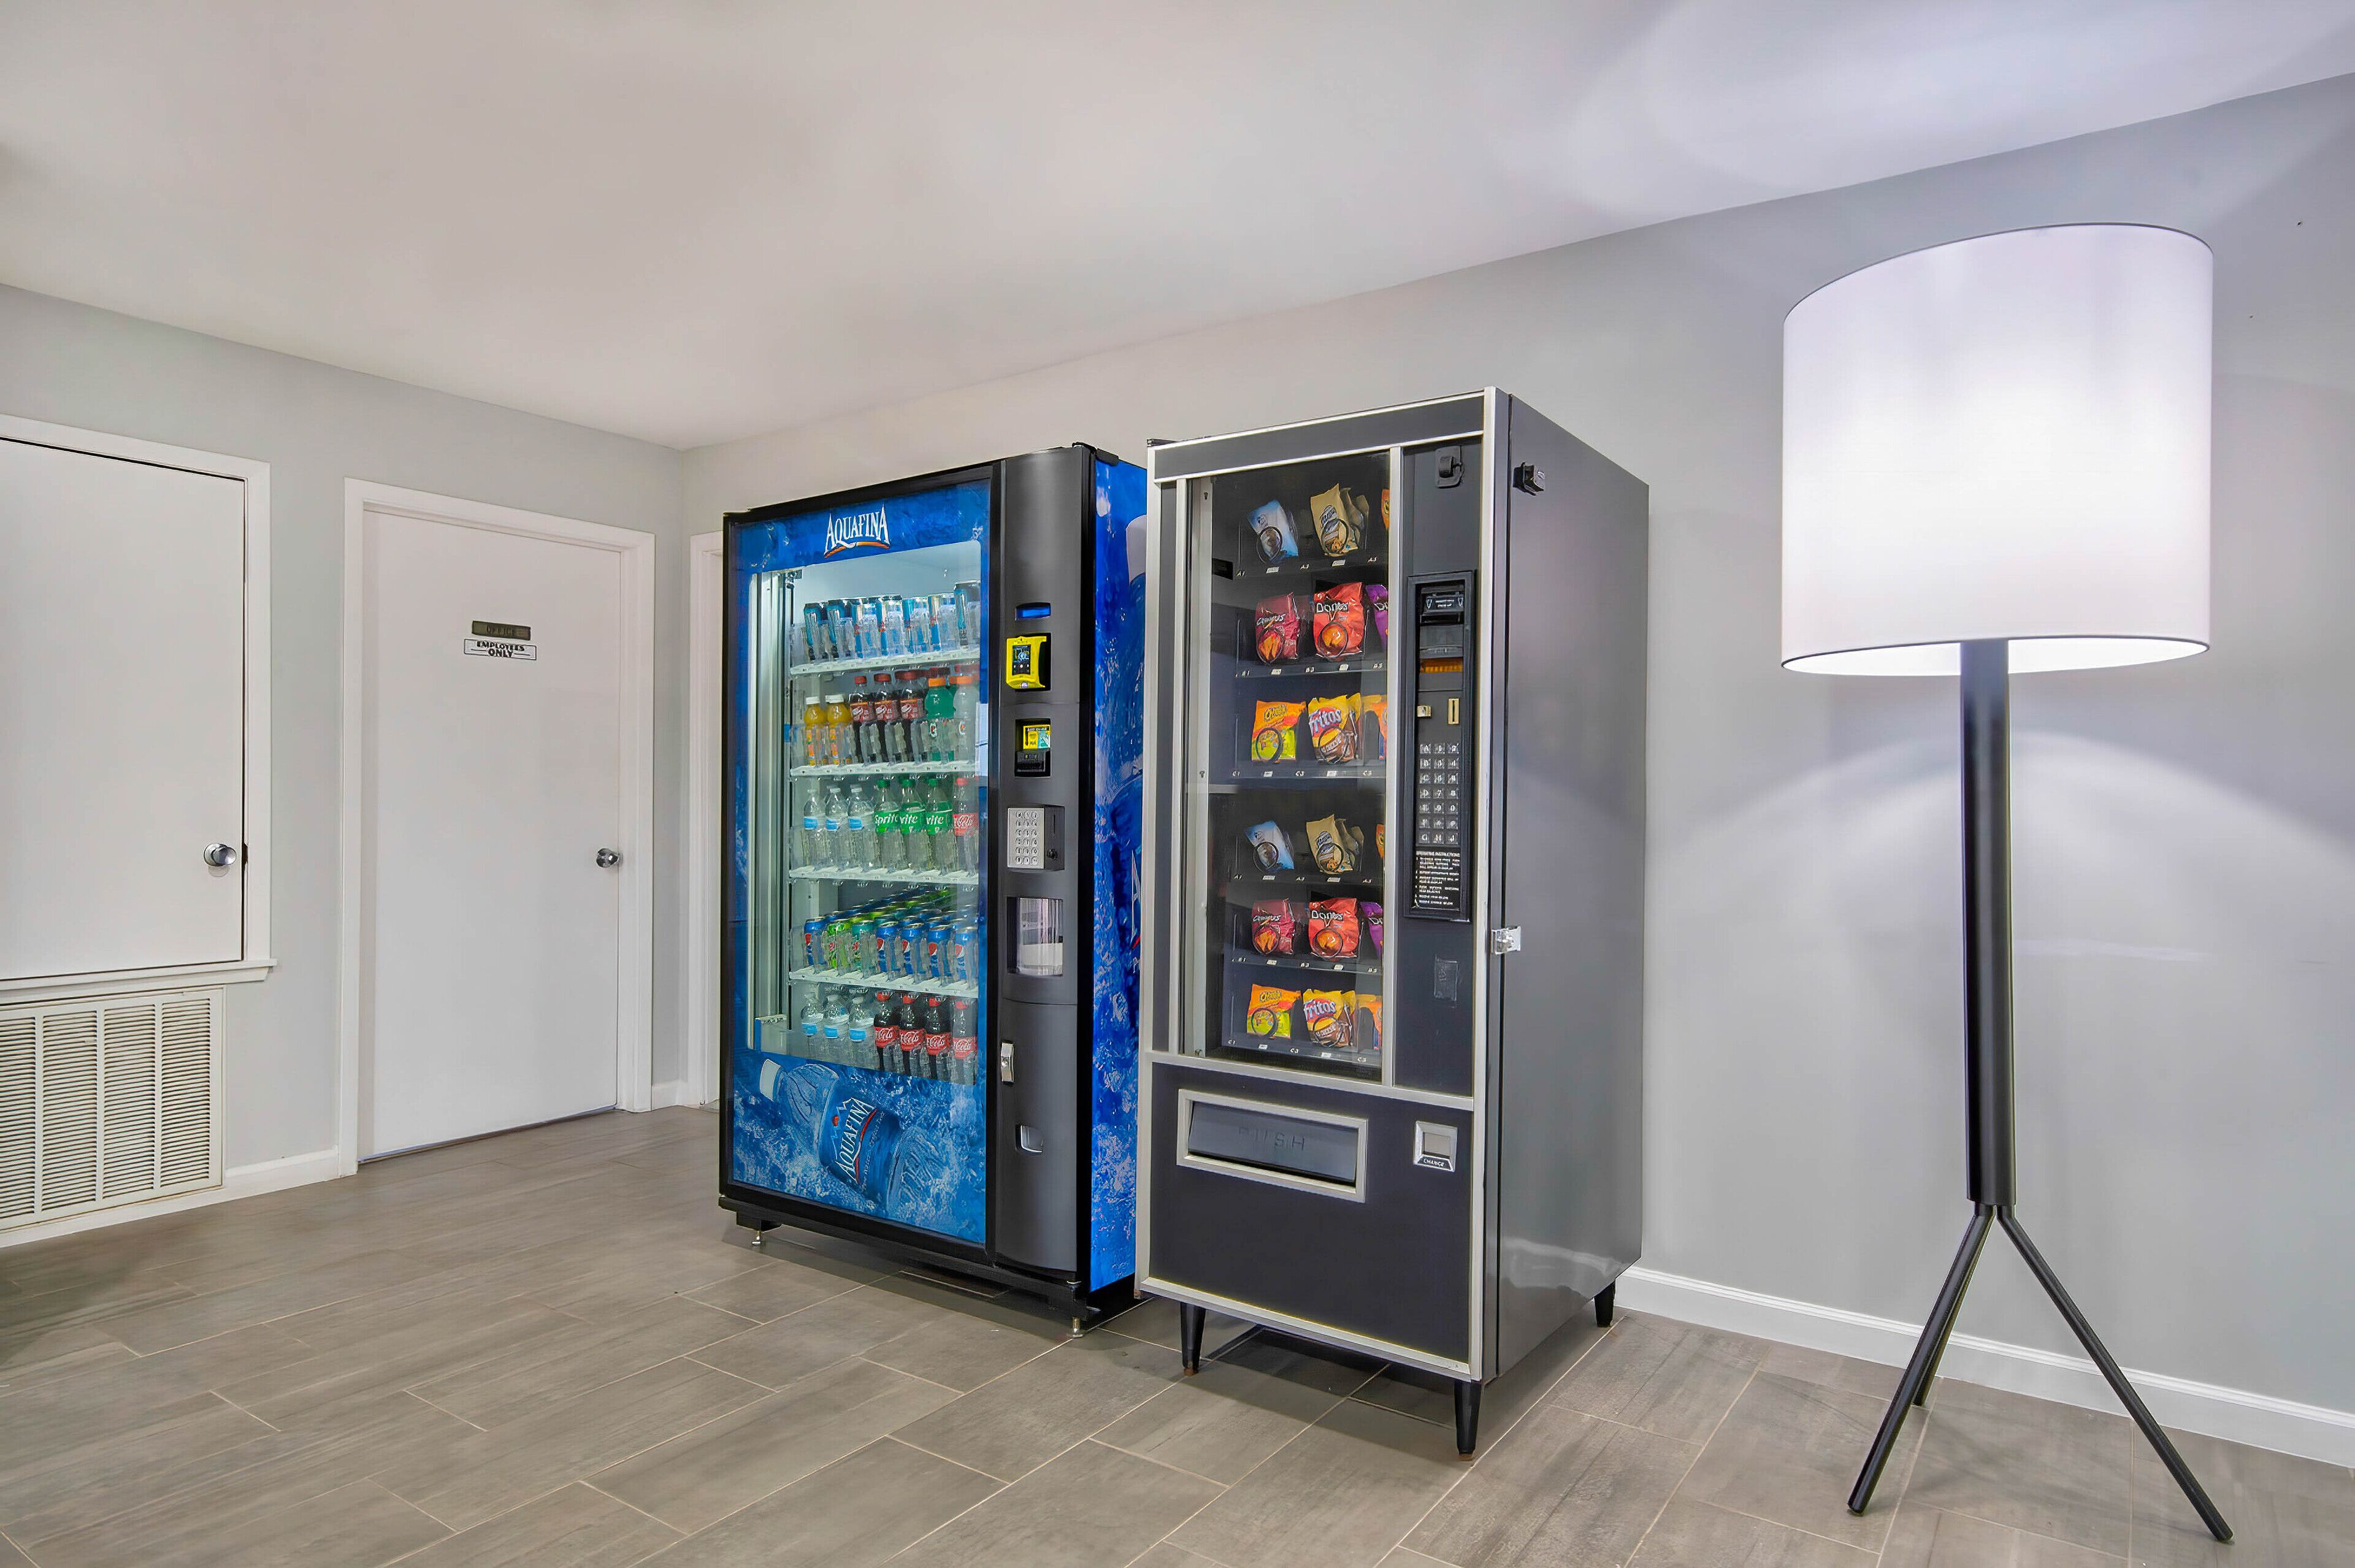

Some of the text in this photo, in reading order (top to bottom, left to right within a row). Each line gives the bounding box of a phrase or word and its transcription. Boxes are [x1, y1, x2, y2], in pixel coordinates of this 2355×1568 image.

[824, 503, 889, 554] AQUAFINA
[477, 641, 525, 651] EMPLOYEES
[488, 649, 514, 658] ONLY
[1309, 709, 1341, 736] Fritos
[1303, 999, 1336, 1019] Fritos
[835, 1098, 875, 1184] AQUAFINA
